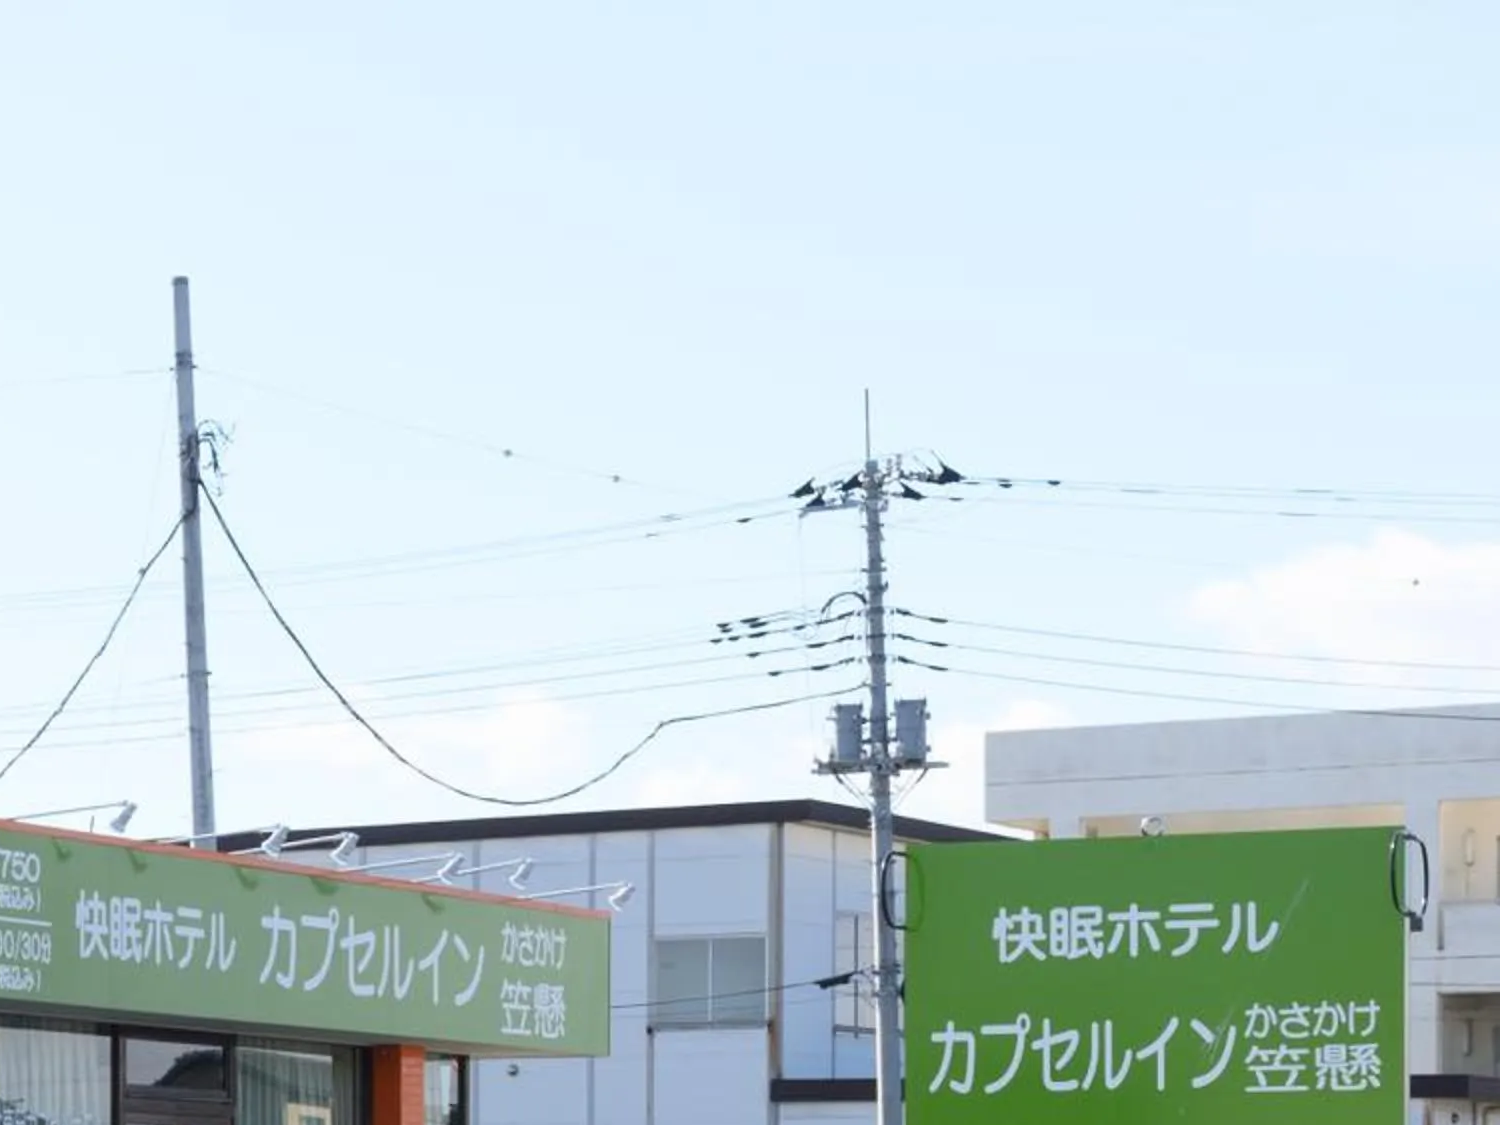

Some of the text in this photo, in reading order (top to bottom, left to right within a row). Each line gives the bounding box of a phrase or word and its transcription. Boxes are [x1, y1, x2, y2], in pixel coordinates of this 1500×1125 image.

[75, 888, 485, 1006] 快眠ホテル カプセルイン
[501, 920, 567, 970] かさかけ
[992, 900, 1280, 963] 快眠ホテル
[500, 979, 566, 1039] 笠懸
[1244, 999, 1381, 1039] かさかけ
[928, 1012, 1383, 1094] カプセルイン 笠懸
